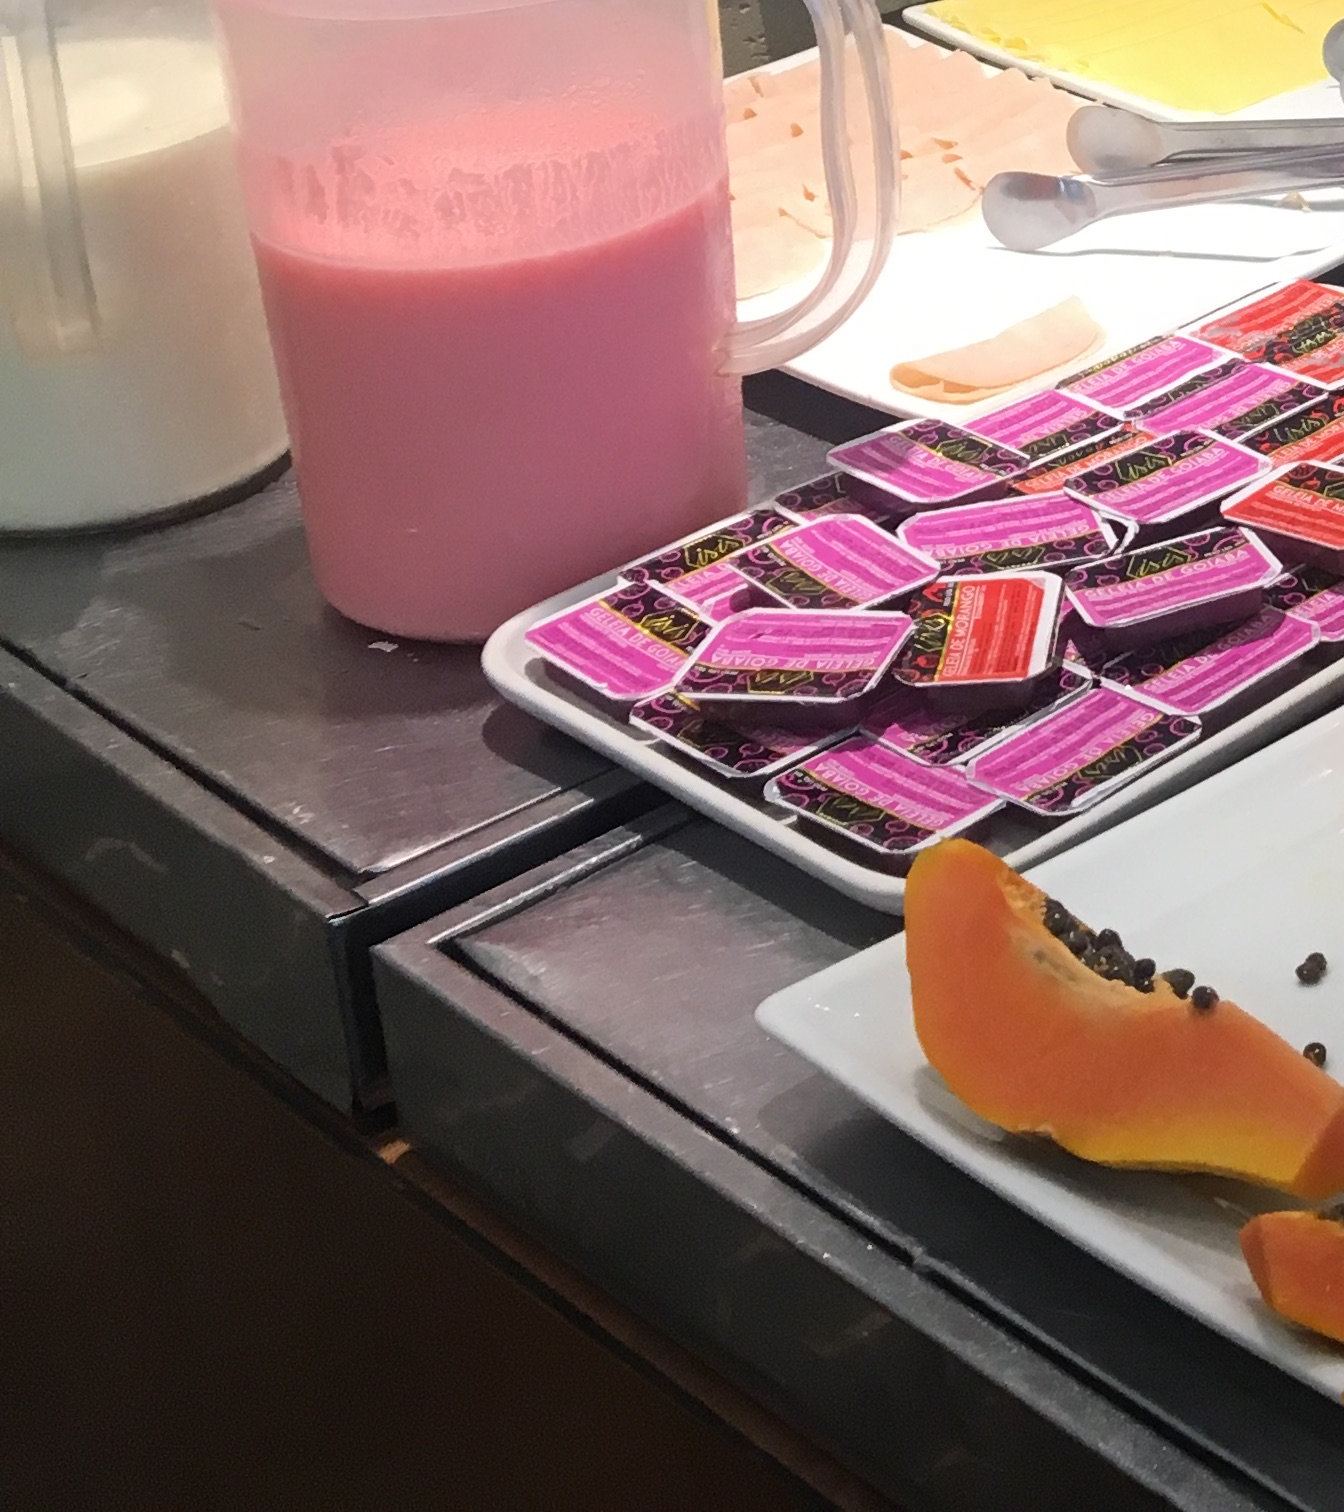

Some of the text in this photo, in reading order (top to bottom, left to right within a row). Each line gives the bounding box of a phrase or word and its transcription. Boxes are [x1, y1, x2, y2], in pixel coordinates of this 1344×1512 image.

[1125, 453, 1165, 481] isis
[1272, 486, 1314, 504] GELEIA
[1316, 499, 1332, 509] DE
[1084, 580, 1149, 598] GELEIA
[1152, 573, 1174, 584] DE
[1181, 548, 1249, 574] GOIABA
[1137, 552, 1184, 577] isis
[955, 585, 975, 636] MORANGO
[590, 608, 685, 668] GELEIA DE GOIA
[954, 635, 965, 650] DE
[711, 652, 875, 669] GELEIA DE GOIABA
[814, 762, 870, 798] GOIABA
[871, 793, 893, 807] DE
[893, 801, 946, 827] GELEIA
